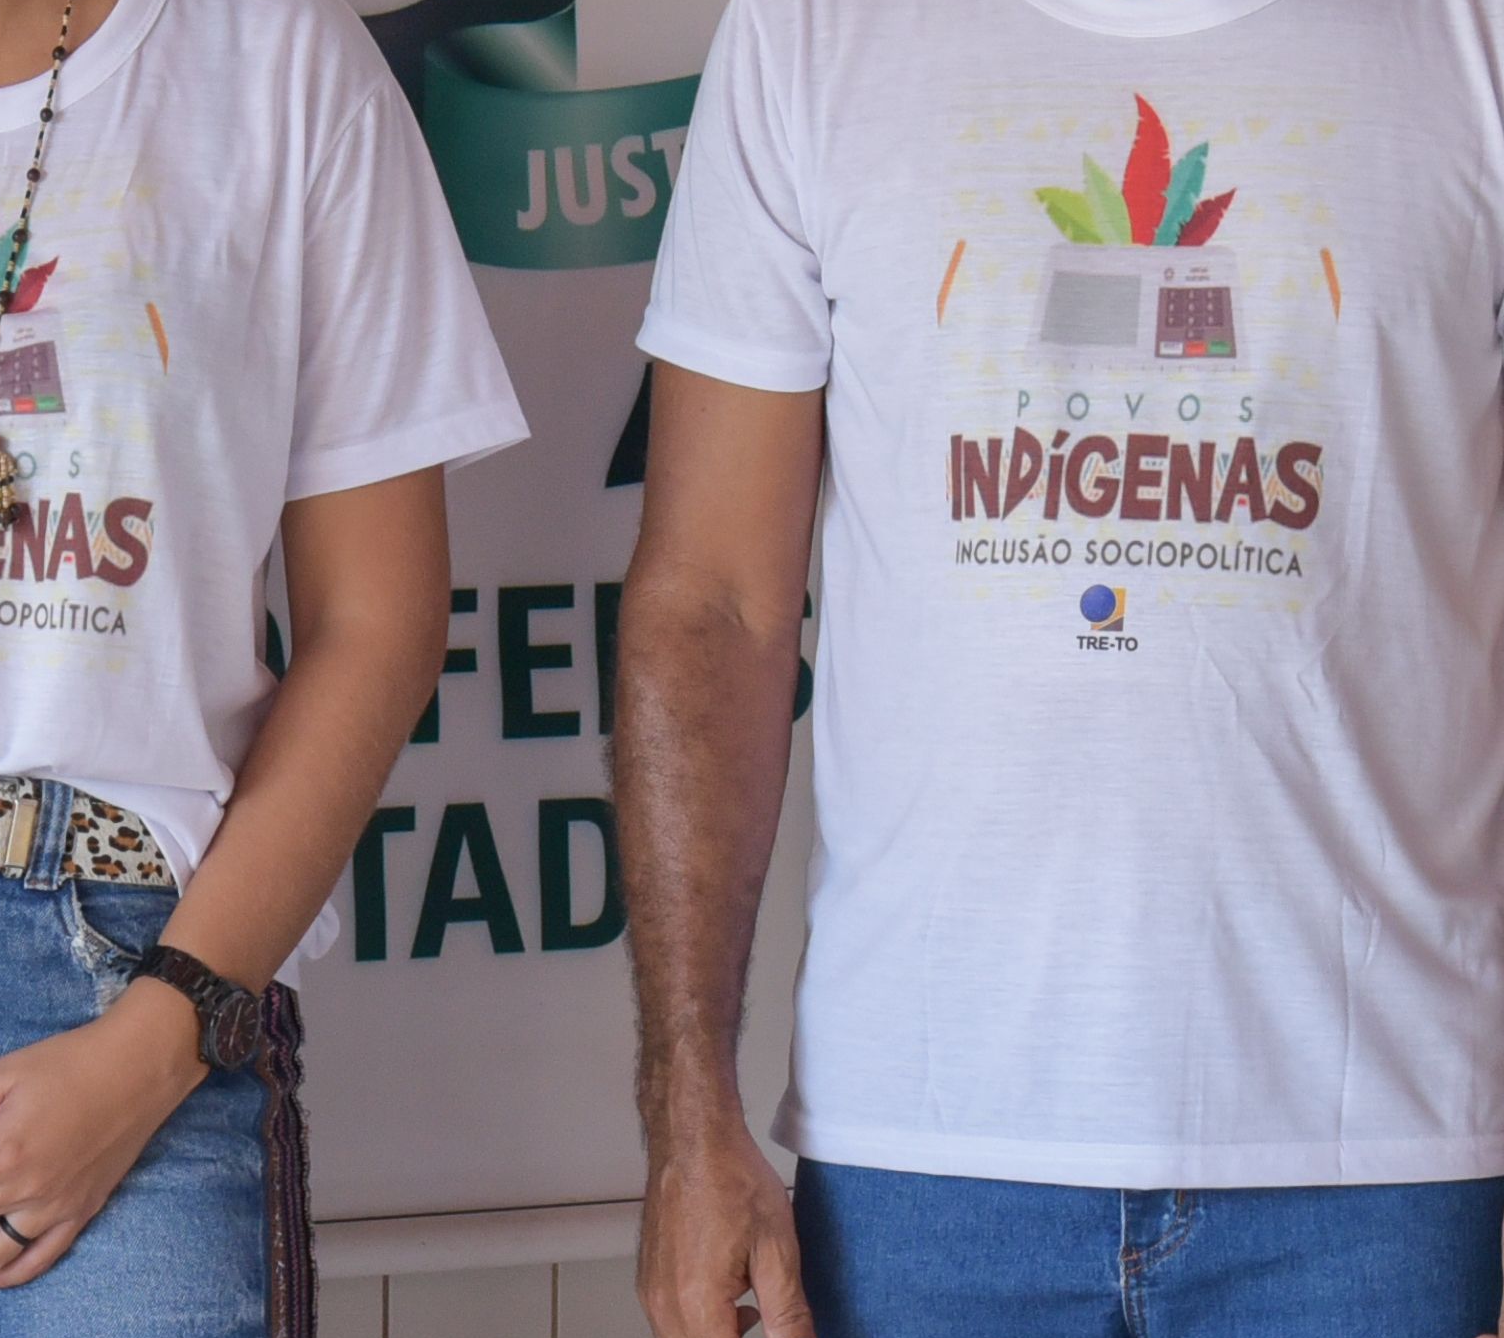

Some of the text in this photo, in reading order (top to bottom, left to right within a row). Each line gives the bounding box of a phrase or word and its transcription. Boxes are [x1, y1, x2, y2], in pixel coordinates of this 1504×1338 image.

[517, 124, 690, 232] JUST
[1017, 390, 1253, 423] POVOS
[950, 426, 1323, 531] INDÍGENAS
[955, 534, 1303, 578] INCLUSÃO SOCIOPOLÍTICA
[1076, 635, 1139, 651] TRE-TO
